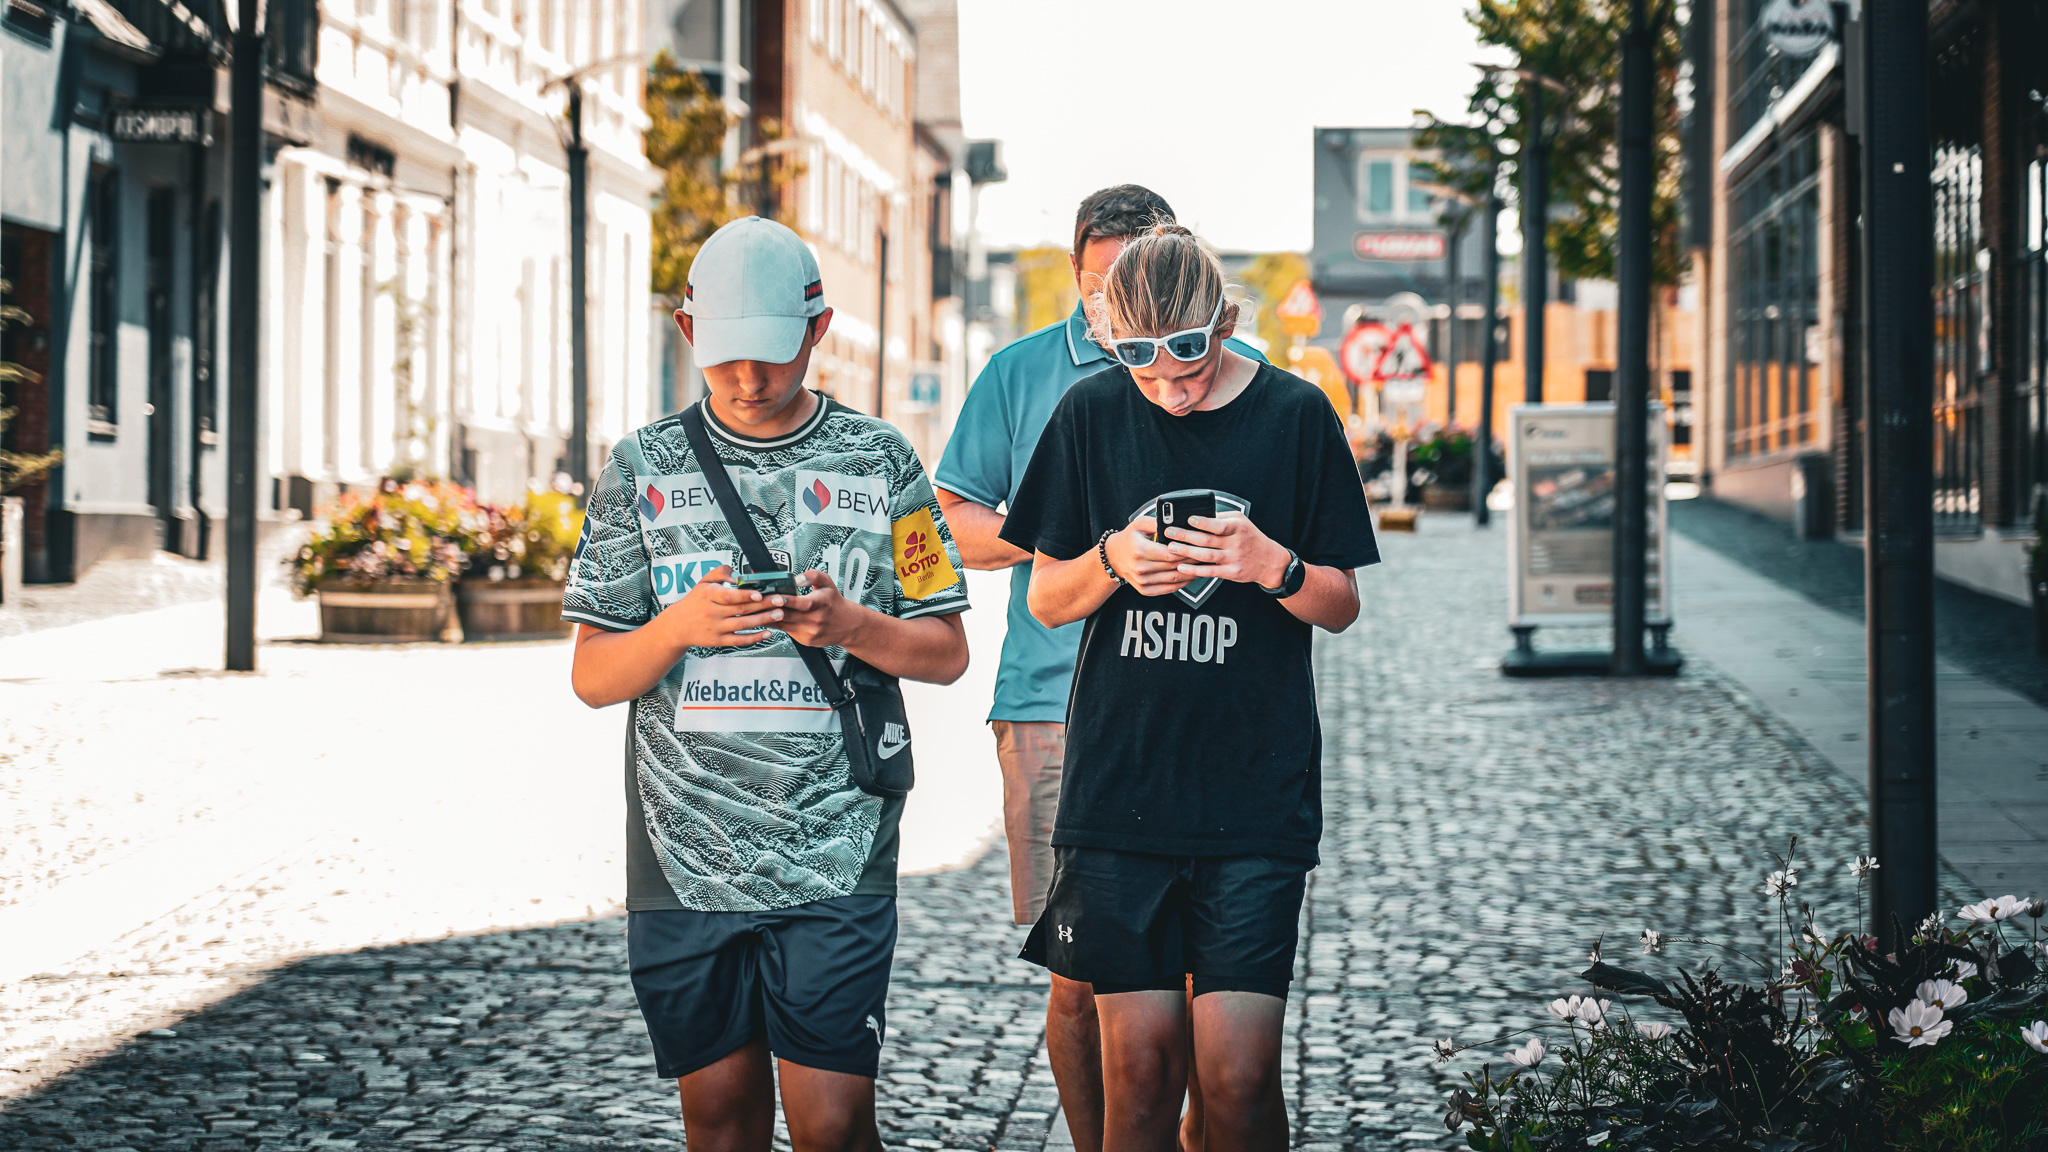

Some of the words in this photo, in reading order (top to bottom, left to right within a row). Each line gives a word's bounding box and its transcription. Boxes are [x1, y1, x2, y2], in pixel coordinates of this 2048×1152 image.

[838, 489, 890, 517] BEW
[823, 544, 870, 604] 10
[900, 553, 939, 578] LOTTO
[917, 571, 935, 583] Berlin
[1120, 610, 1238, 664] HSHOP
[884, 722, 904, 743] NIKE
